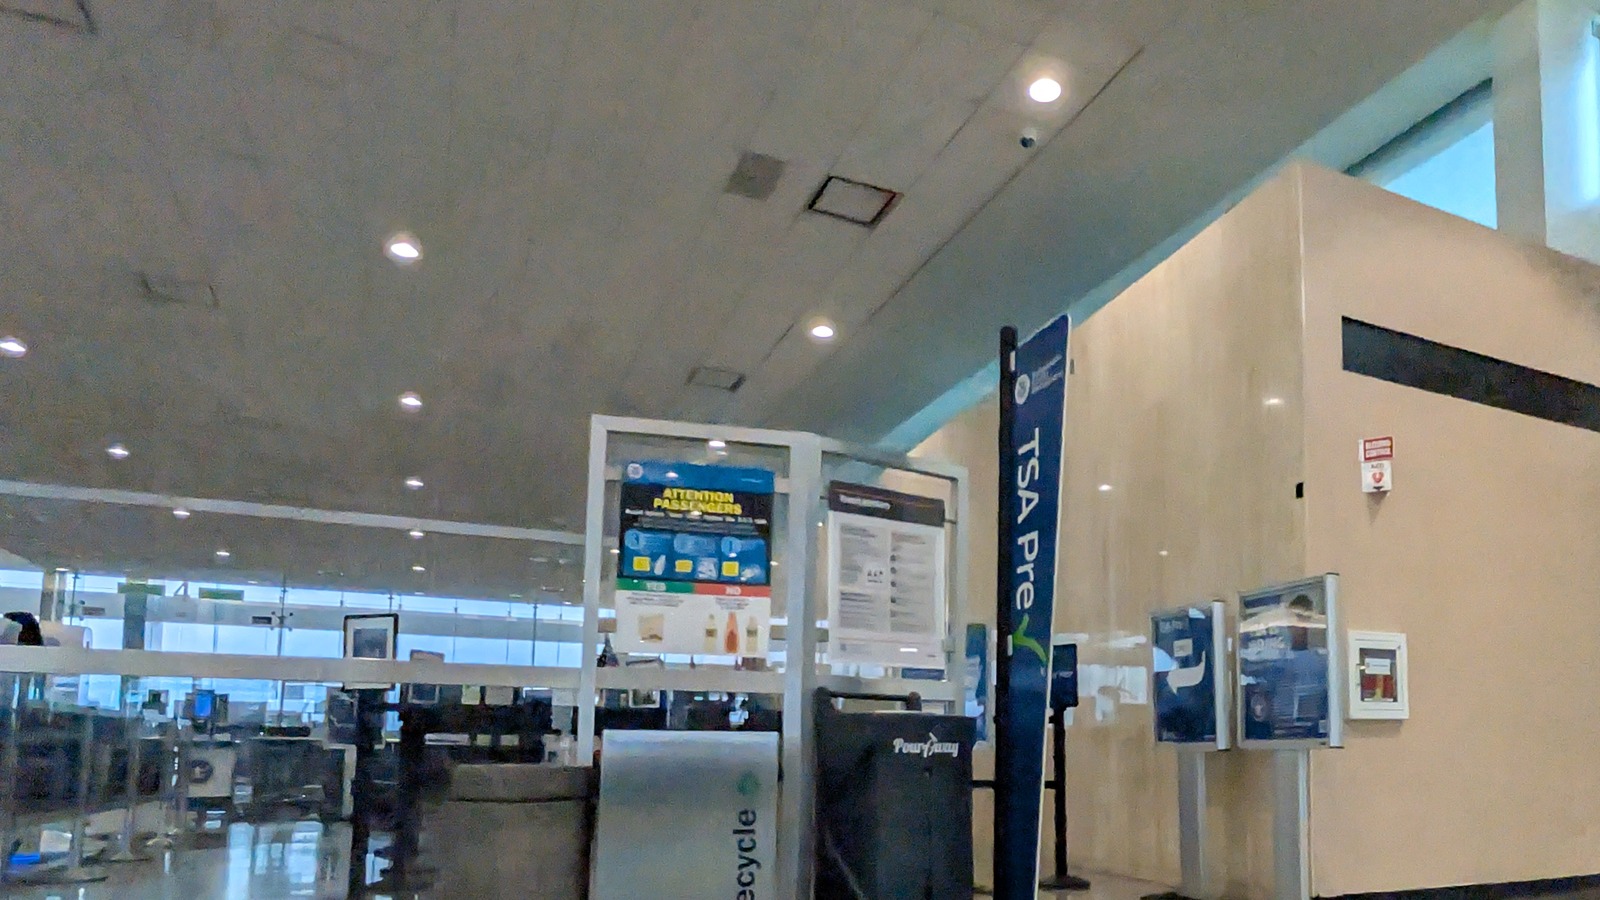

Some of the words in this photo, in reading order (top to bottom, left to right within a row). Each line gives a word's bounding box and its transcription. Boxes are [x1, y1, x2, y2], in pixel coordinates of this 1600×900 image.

[662, 487, 735, 504] ATTENTION
[1017, 427, 1040, 525] TSA
[652, 497, 743, 515] PASSENGERS
[725, 585, 742, 595] NO
[1015, 530, 1040, 610] Pre
[732, 808, 762, 900] ecycle
